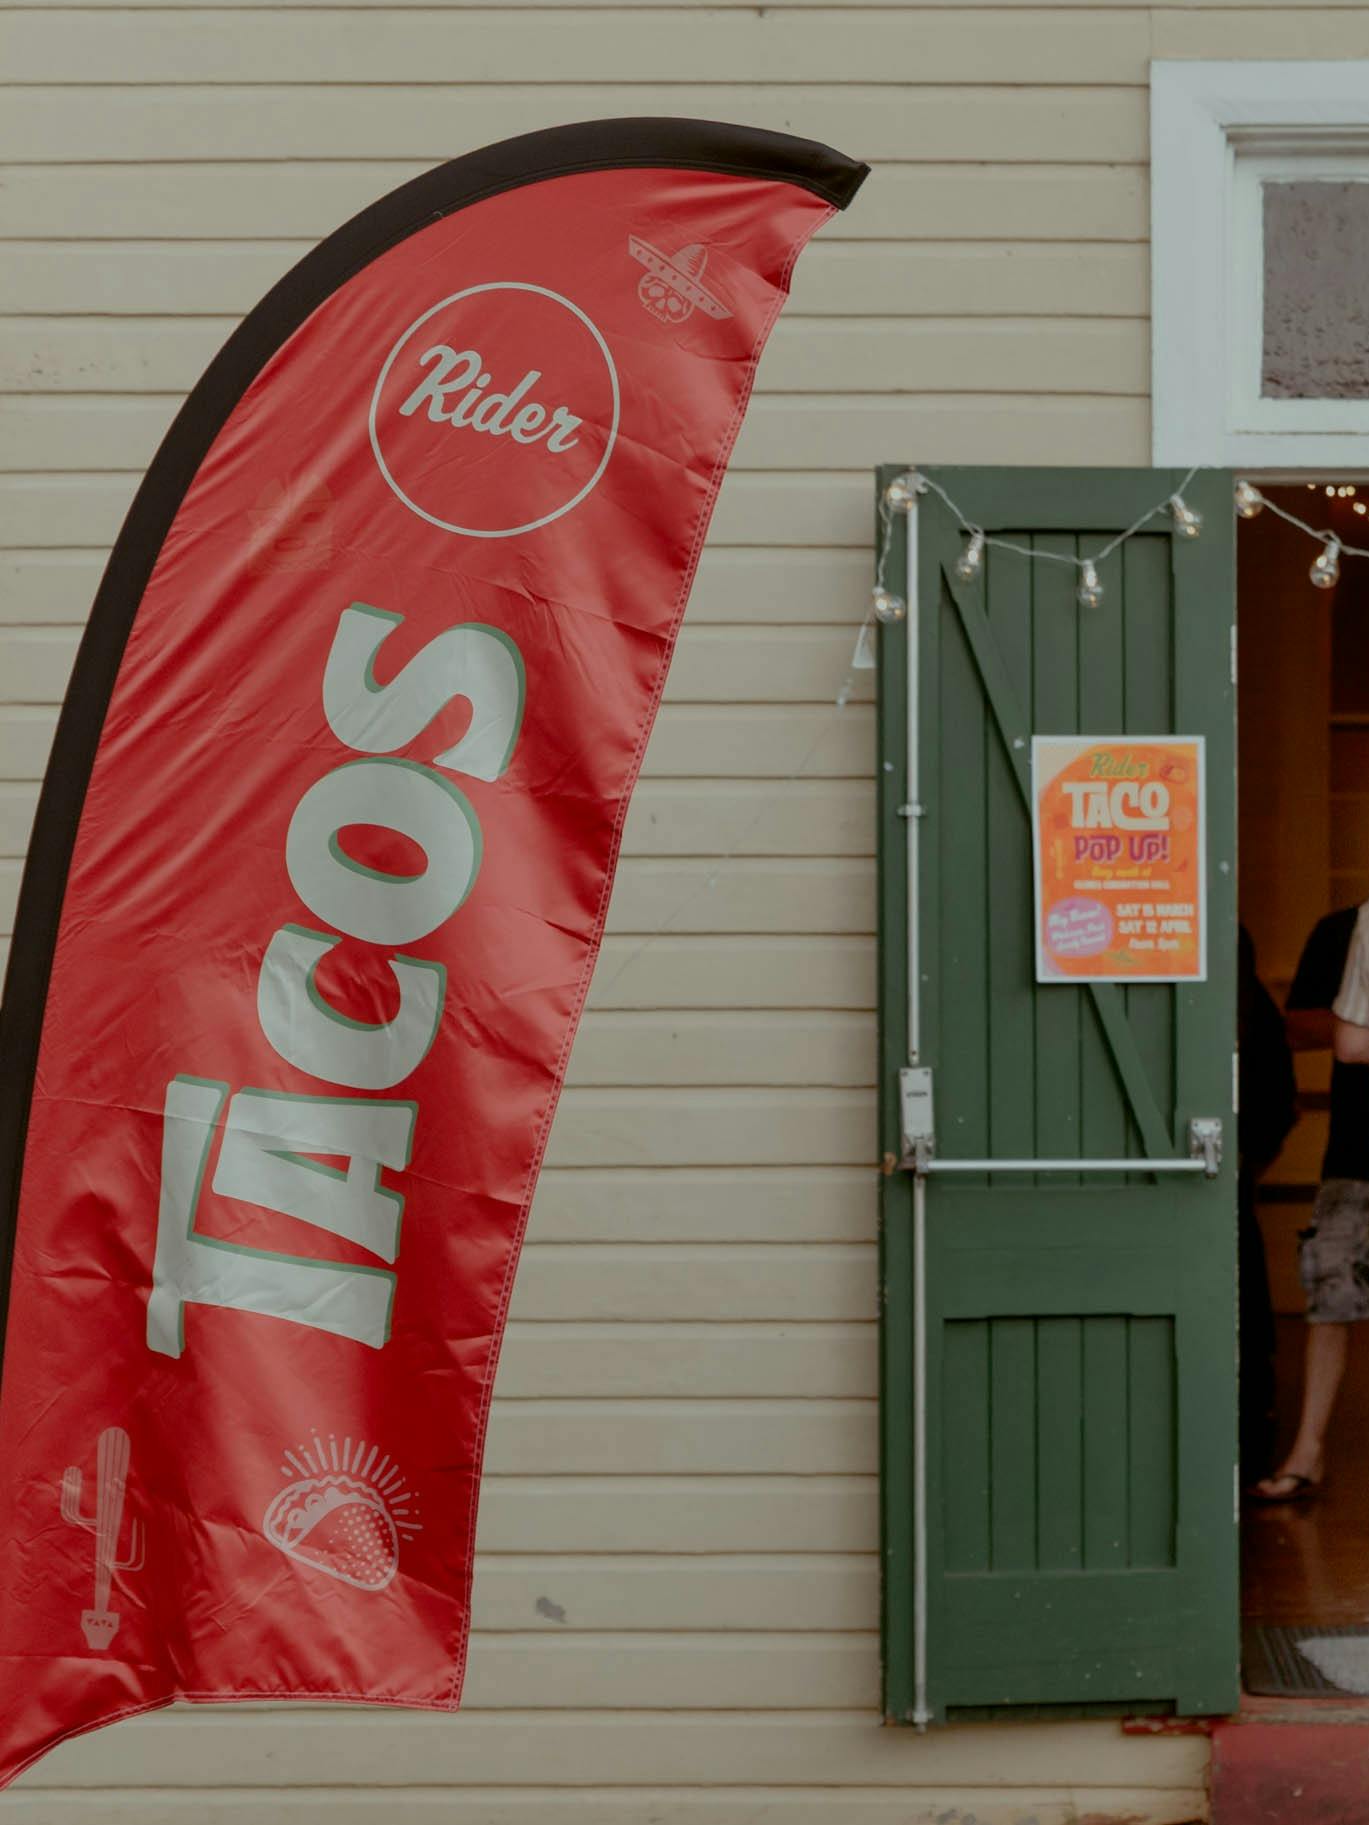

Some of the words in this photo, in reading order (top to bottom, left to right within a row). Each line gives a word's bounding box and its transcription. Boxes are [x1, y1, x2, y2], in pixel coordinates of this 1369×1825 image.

[398, 344, 583, 453] Rider
[1089, 752, 1149, 778] Rider
[1062, 781, 1170, 830] TACO
[1073, 834, 1122, 863] POP
[1128, 834, 1171, 864] UP!
[146, 602, 526, 1359] TACOS
